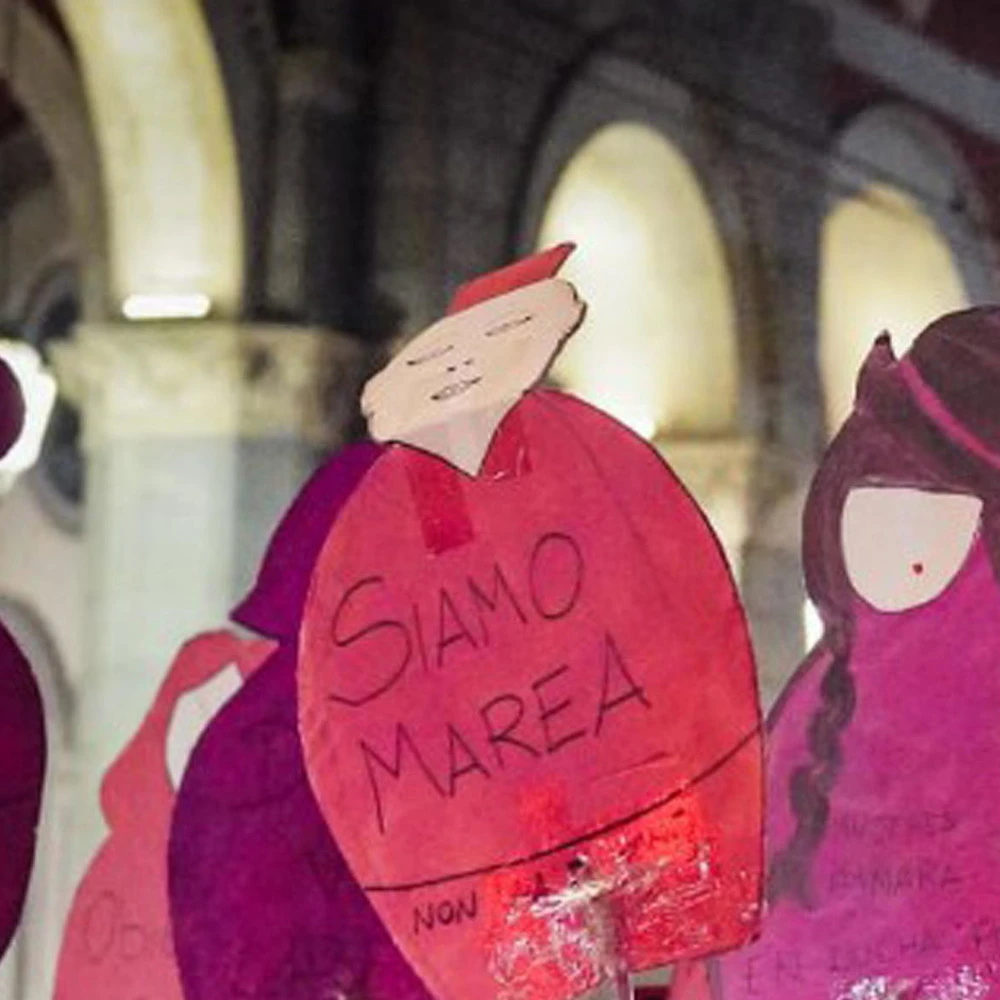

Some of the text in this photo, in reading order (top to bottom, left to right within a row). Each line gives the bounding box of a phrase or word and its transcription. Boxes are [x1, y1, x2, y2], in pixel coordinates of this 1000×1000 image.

[330, 532, 583, 706] SIAMO
[360, 633, 651, 836] MAREA
[413, 891, 477, 934] NON
